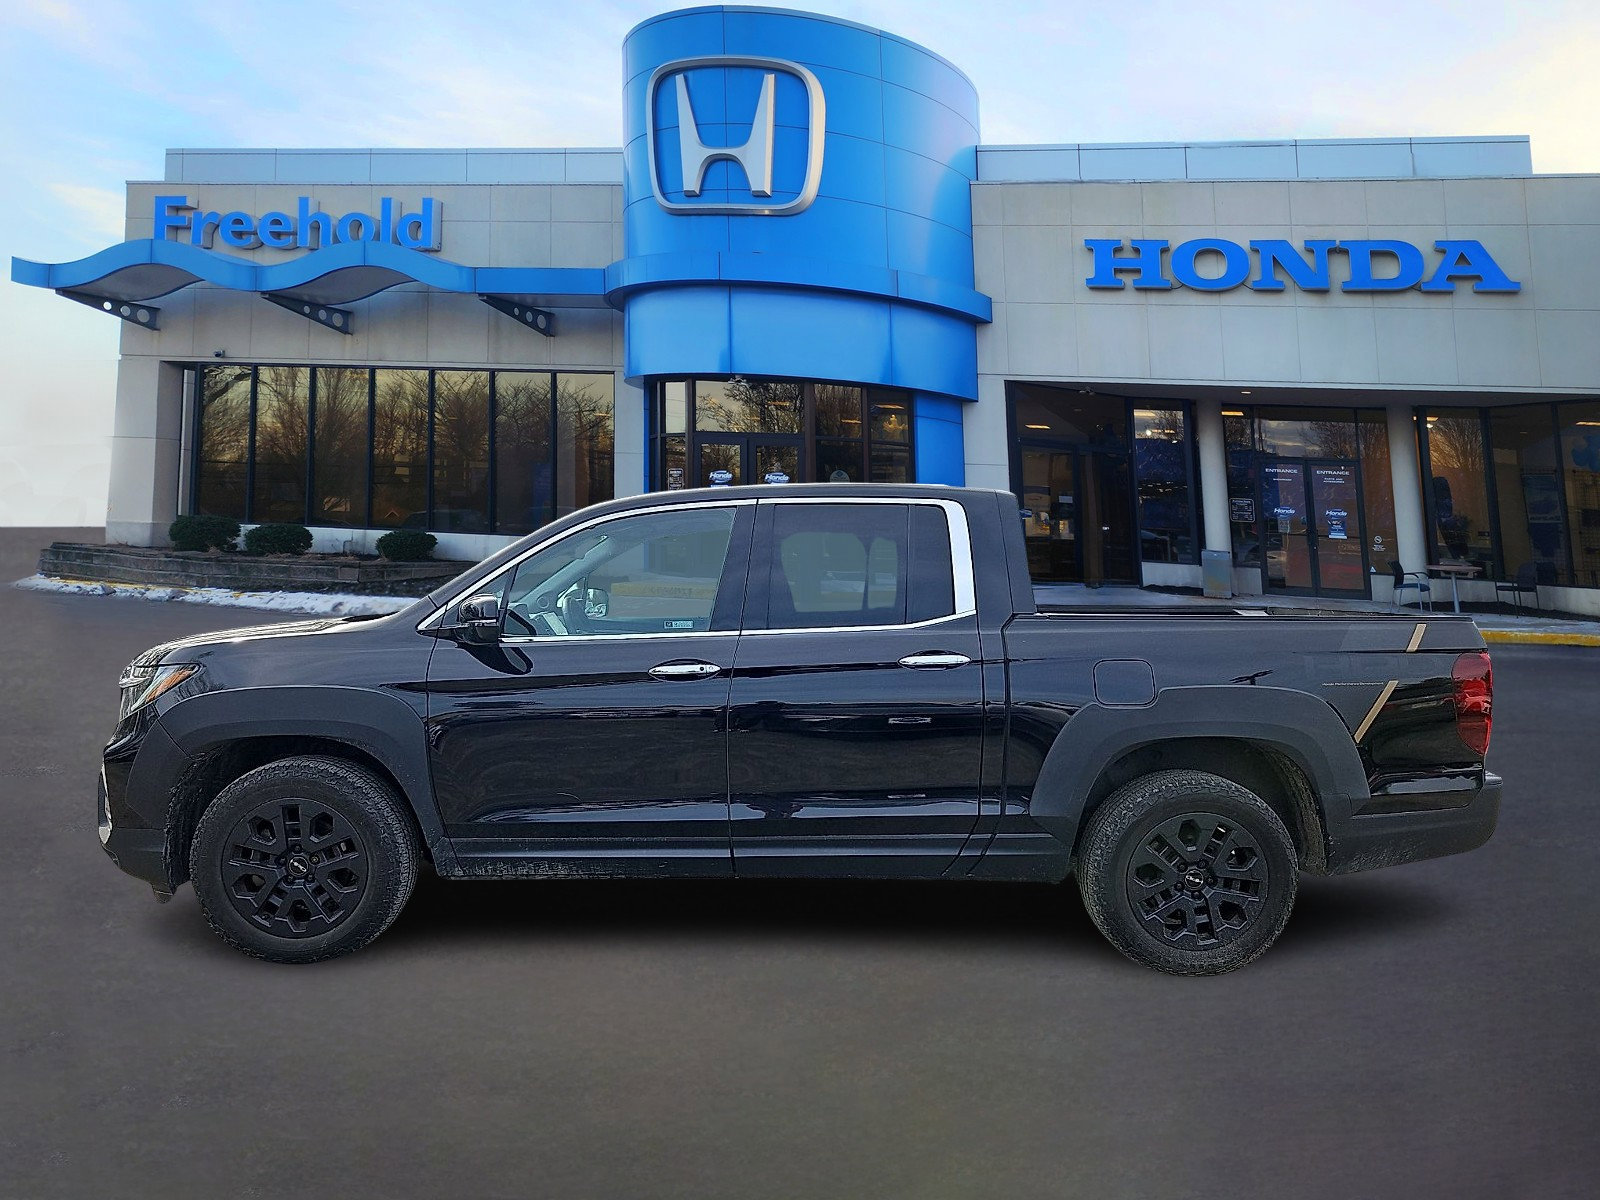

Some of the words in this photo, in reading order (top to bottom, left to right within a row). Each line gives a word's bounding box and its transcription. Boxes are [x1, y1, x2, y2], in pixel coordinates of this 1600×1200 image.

[153, 195, 438, 249] Freehold
[1084, 238, 1522, 292] HONDA
[709, 471, 733, 480] Honda
[764, 474, 789, 482] Honda
